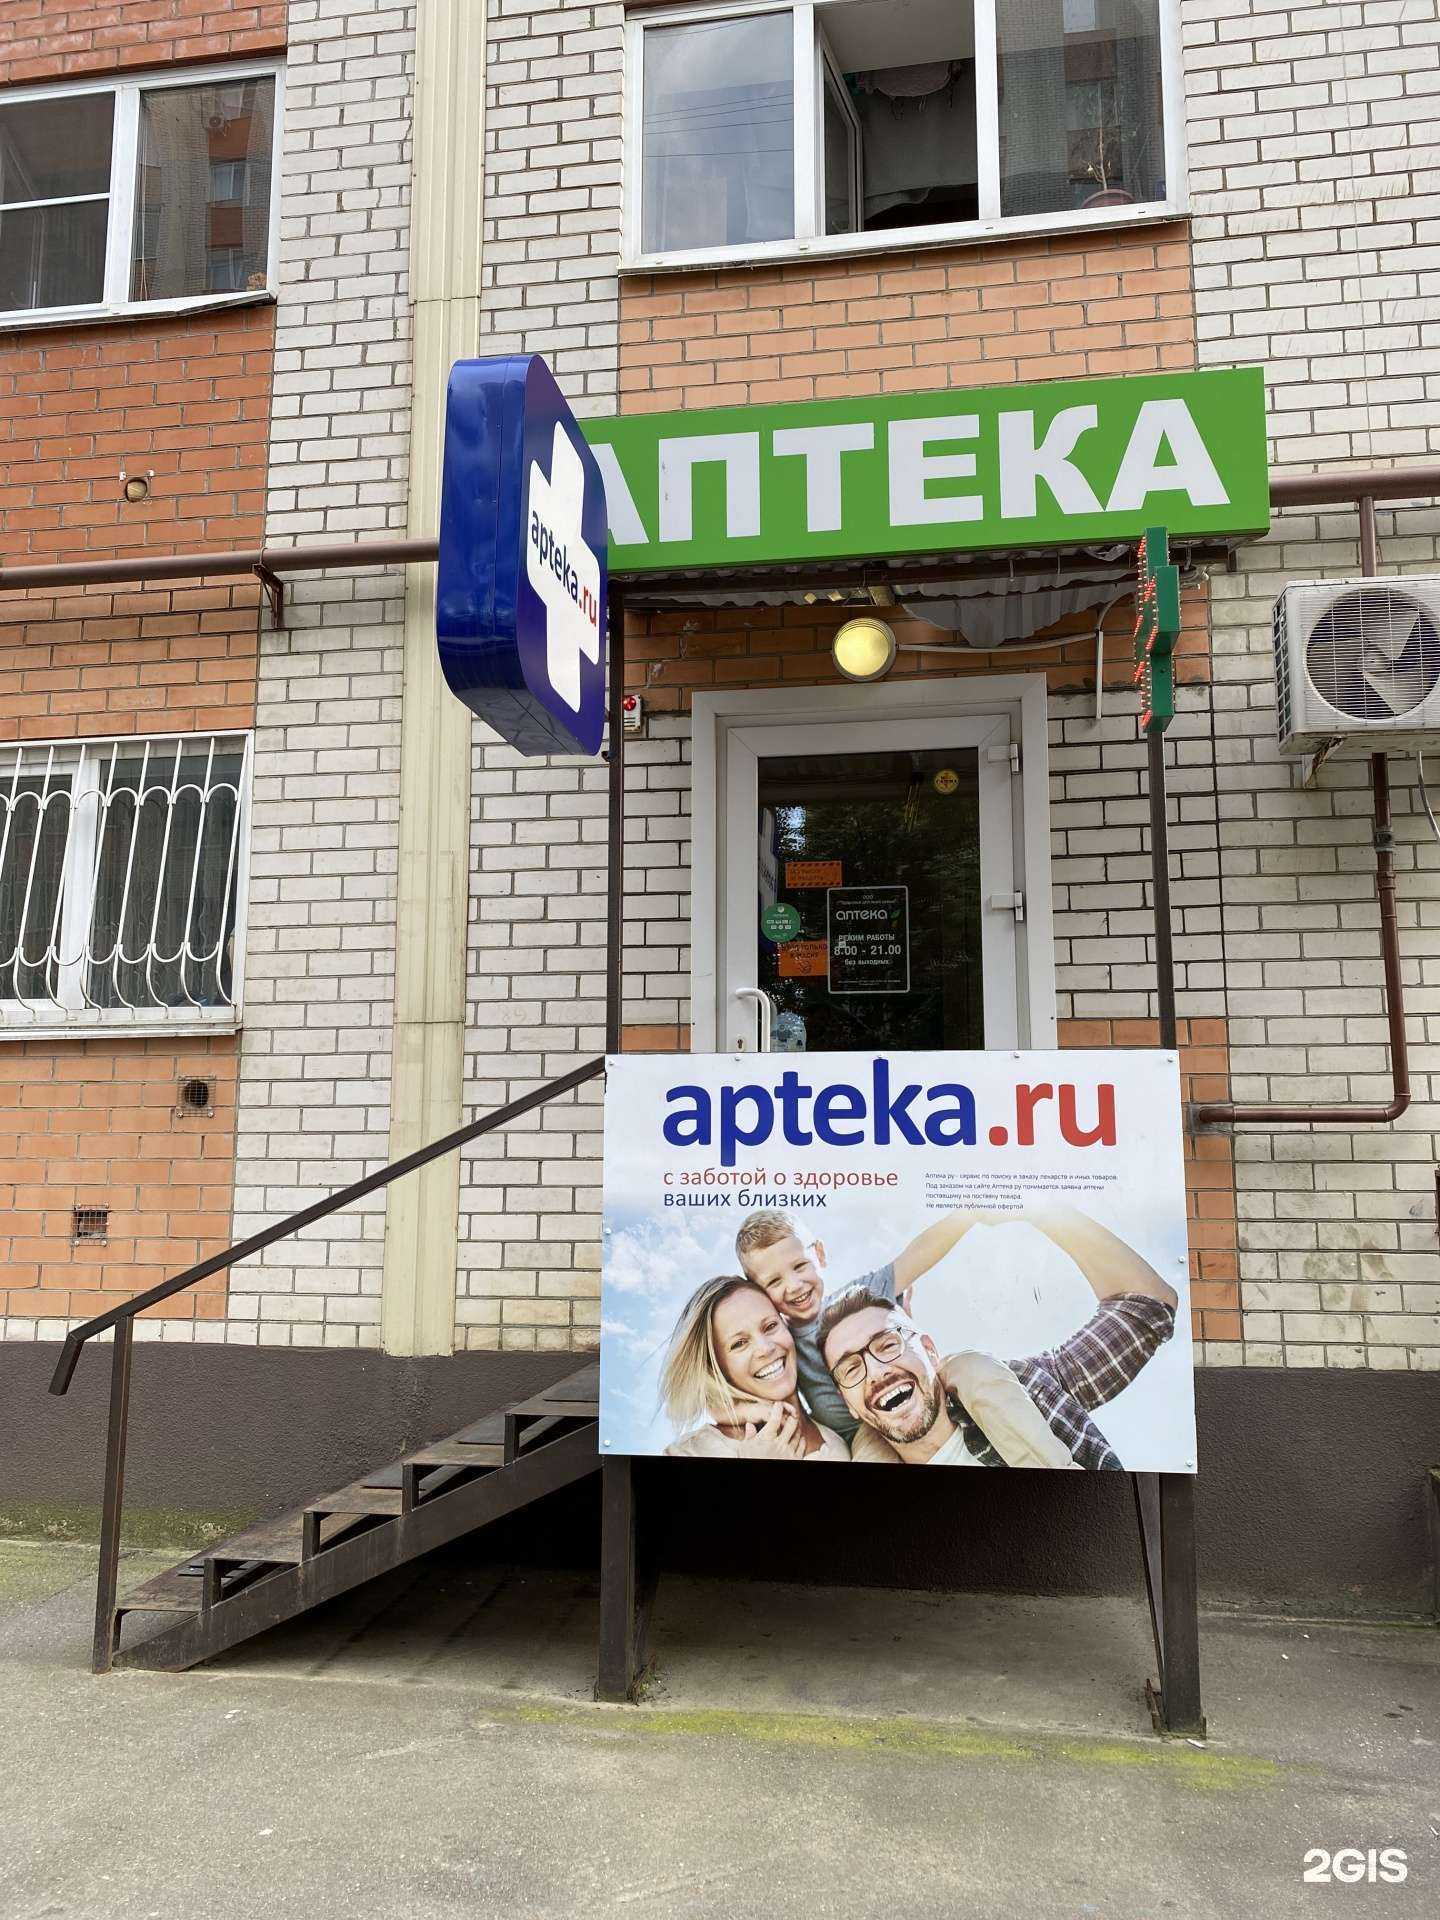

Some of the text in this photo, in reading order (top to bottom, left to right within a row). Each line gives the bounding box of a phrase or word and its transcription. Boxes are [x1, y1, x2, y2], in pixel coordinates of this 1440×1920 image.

[531, 510, 597, 627] apteka.ru
[836, 909, 888, 921] аптека
[866, 933, 895, 941] РАБОТЫ
[834, 945, 858, 956] 8.00
[870, 944, 902, 956] 21.00
[844, 958, 856, 966] без
[663, 1058, 1118, 1166] apteka.ru
[663, 1168, 899, 1190] с заботой о здоровье
[664, 1189, 828, 1207] ваших близких
